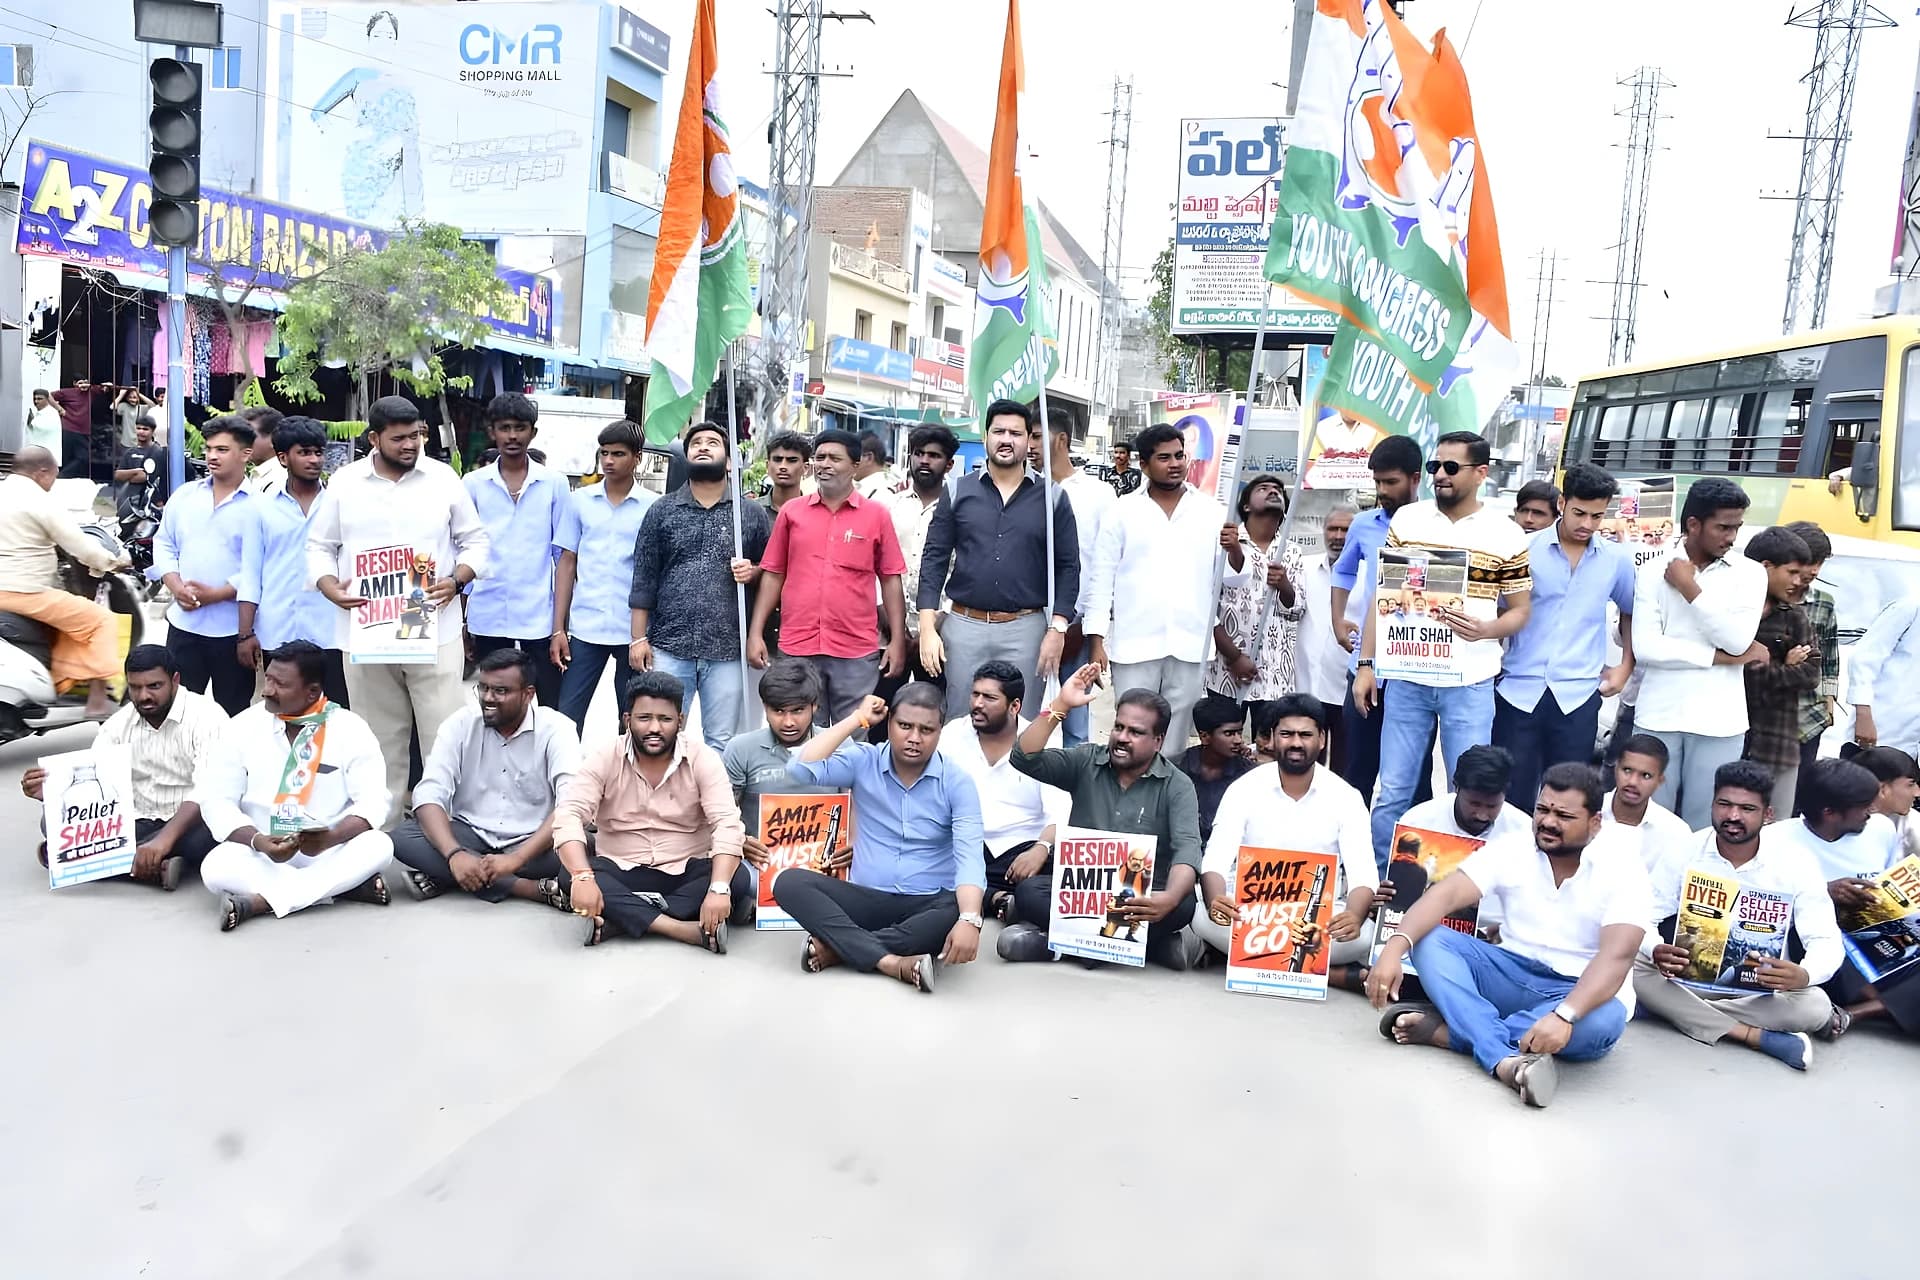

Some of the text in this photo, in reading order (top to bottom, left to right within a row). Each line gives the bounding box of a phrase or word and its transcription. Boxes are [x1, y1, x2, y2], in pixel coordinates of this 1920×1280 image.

[460, 24, 562, 65] CMR
[459, 70, 562, 81] SHOPPING MALL
[129, 181, 254, 266] CTON
[1286, 213, 1352, 286] YOUTH
[1351, 245, 1450, 361] CONGRESS
[1347, 339, 1417, 422] YOUTH
[356, 547, 414, 577] RESIGN
[360, 572, 406, 599] AMIT
[1388, 625, 1453, 644] AMIT SHAH
[67, 799, 120, 825] Pellet
[766, 803, 824, 828] AMIT
[59, 814, 123, 851] SHAH
[765, 823, 820, 847] SHAH
[763, 841, 825, 870] MUST
[1060, 842, 1129, 866] RESIGN
[1060, 868, 1117, 891] AMIT
[1244, 861, 1308, 882] AMIT
[1241, 881, 1304, 903] SHAH
[1686, 883, 1727, 909] DYER
[1740, 896, 1789, 913] PELLET
[1236, 900, 1307, 929] MUST
[1739, 908, 1787, 924] SHAH?
[1243, 925, 1290, 955] GO
